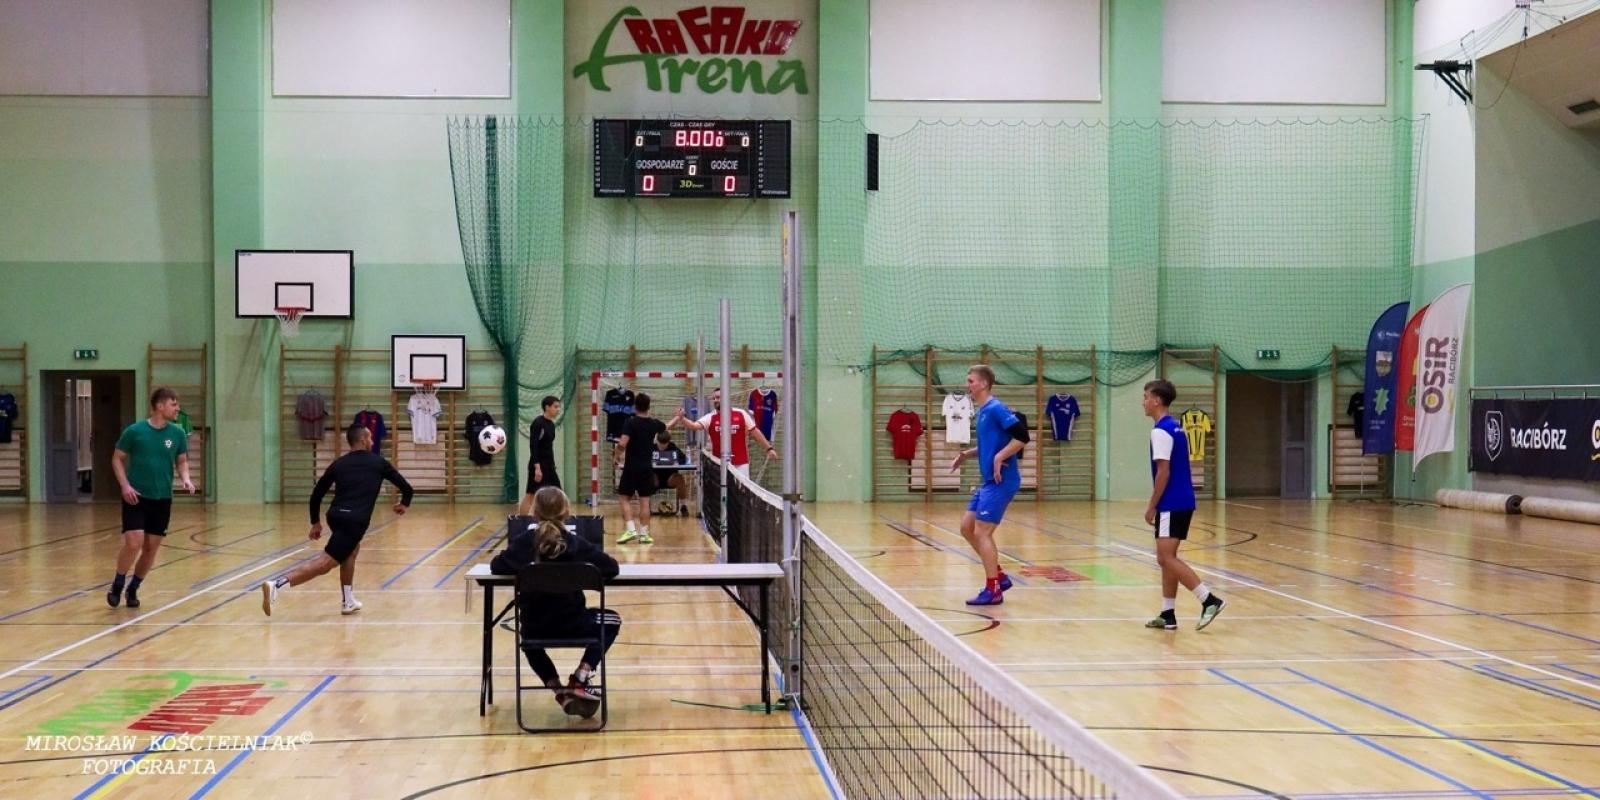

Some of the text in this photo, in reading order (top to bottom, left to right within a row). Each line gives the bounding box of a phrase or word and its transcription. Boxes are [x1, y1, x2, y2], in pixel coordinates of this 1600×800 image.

[624, 6, 802, 55] RAFAKO
[573, 6, 809, 95] Arena
[635, 135, 644, 147] 0
[741, 136, 750, 147] 0
[635, 160, 685, 170] GOSPODARZE
[688, 164, 697, 176] 0
[710, 158, 739, 170] GOŚCIE
[642, 175, 654, 192] 0
[724, 175, 736, 192] 0
[1510, 421, 1567, 450] RACIBÓRZ
